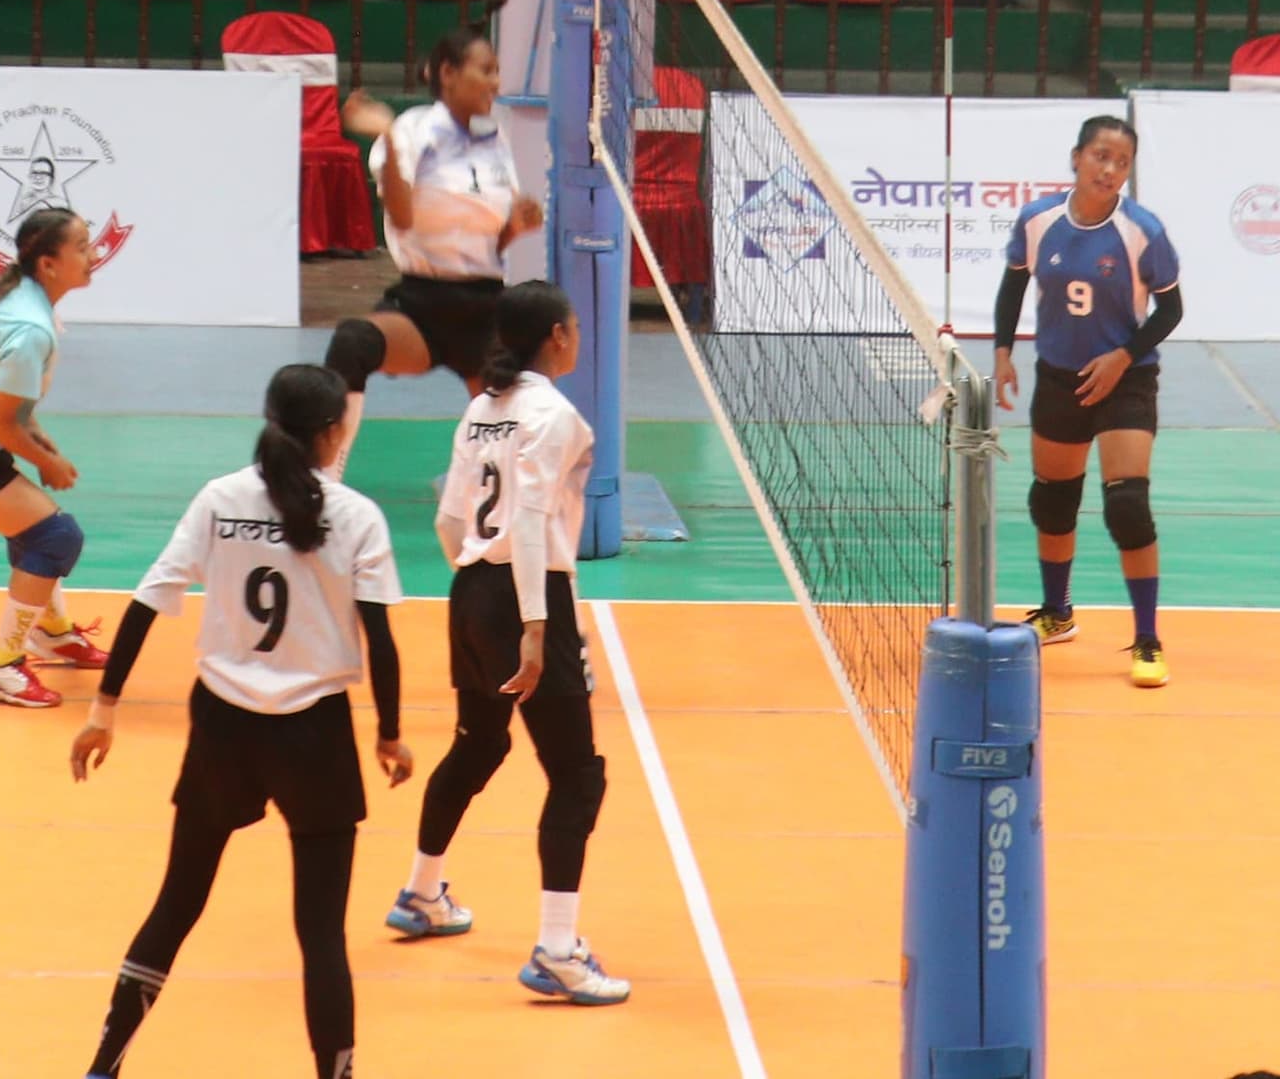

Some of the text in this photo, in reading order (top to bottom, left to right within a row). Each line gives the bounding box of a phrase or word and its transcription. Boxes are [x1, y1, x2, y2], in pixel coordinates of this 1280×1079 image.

[3, 103, 57, 122] Pradhan
[62, 107, 115, 163] Foundation
[851, 167, 974, 207] नेपाल
[1066, 280, 1093, 317] 9
[476, 461, 502, 539] 2
[245, 566, 289, 652] 9
[987, 822, 1013, 951] Senoh
